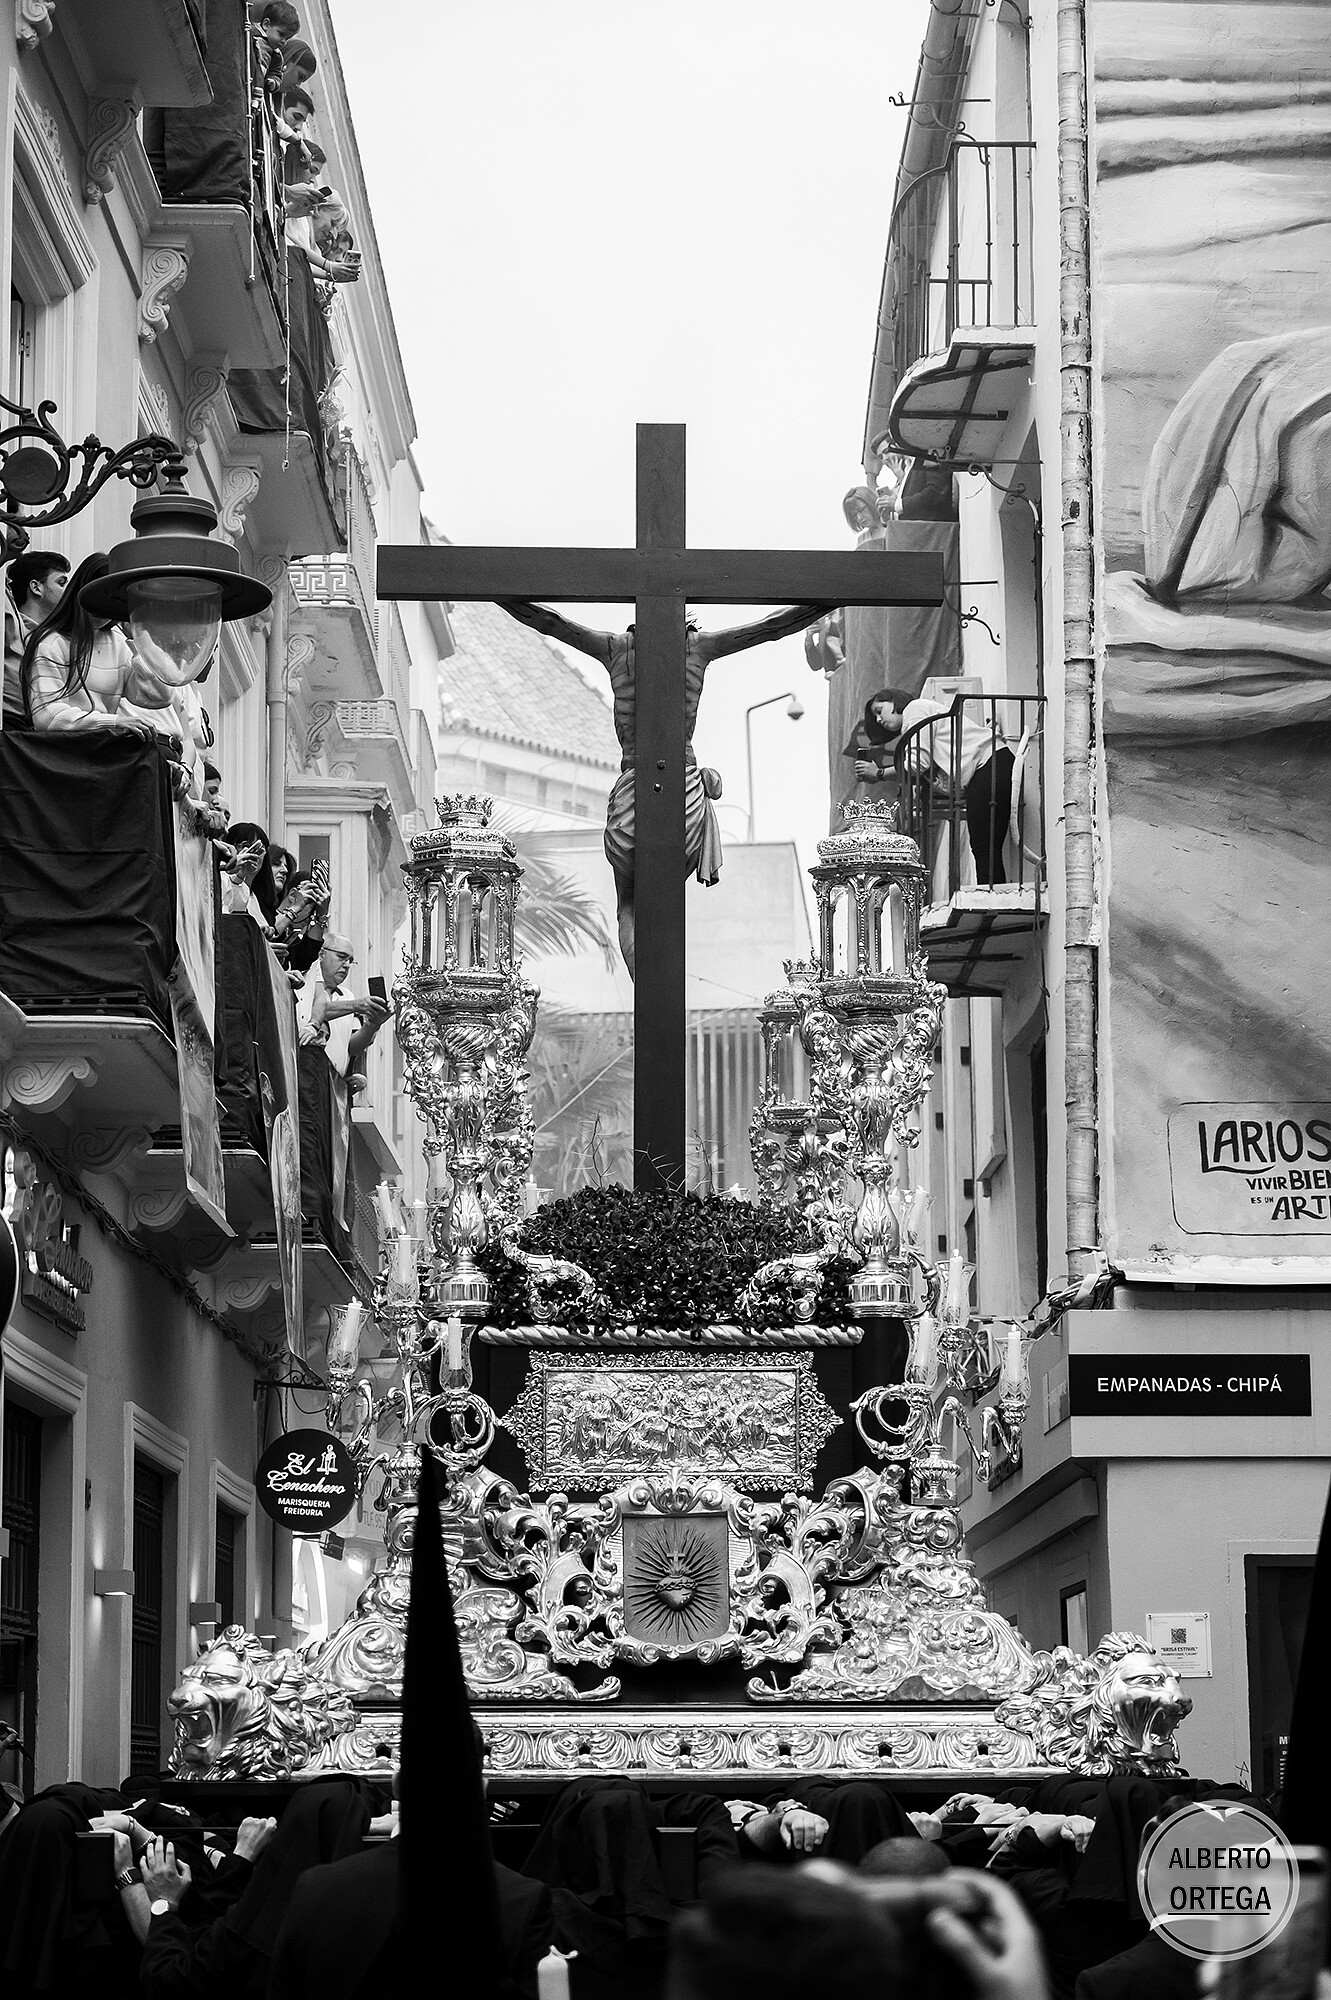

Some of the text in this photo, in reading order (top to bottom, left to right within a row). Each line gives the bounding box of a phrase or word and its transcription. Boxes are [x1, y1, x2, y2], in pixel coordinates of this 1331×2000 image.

[1198, 1119, 1331, 1174] LARIOS
[1245, 1177, 1288, 1190] VIVIR
[1264, 1196, 1274, 1204] UN
[1271, 1195, 1331, 1221] ART
[1097, 1377, 1212, 1393] EMPANADAS
[1227, 1374, 1282, 1393] CHIPÁ
[283, 1452, 316, 1476] El
[267, 1470, 346, 1495] Cenachero
[278, 1497, 331, 1509] MARISQUERIA
[283, 1506, 324, 1517] FREIDURIA
